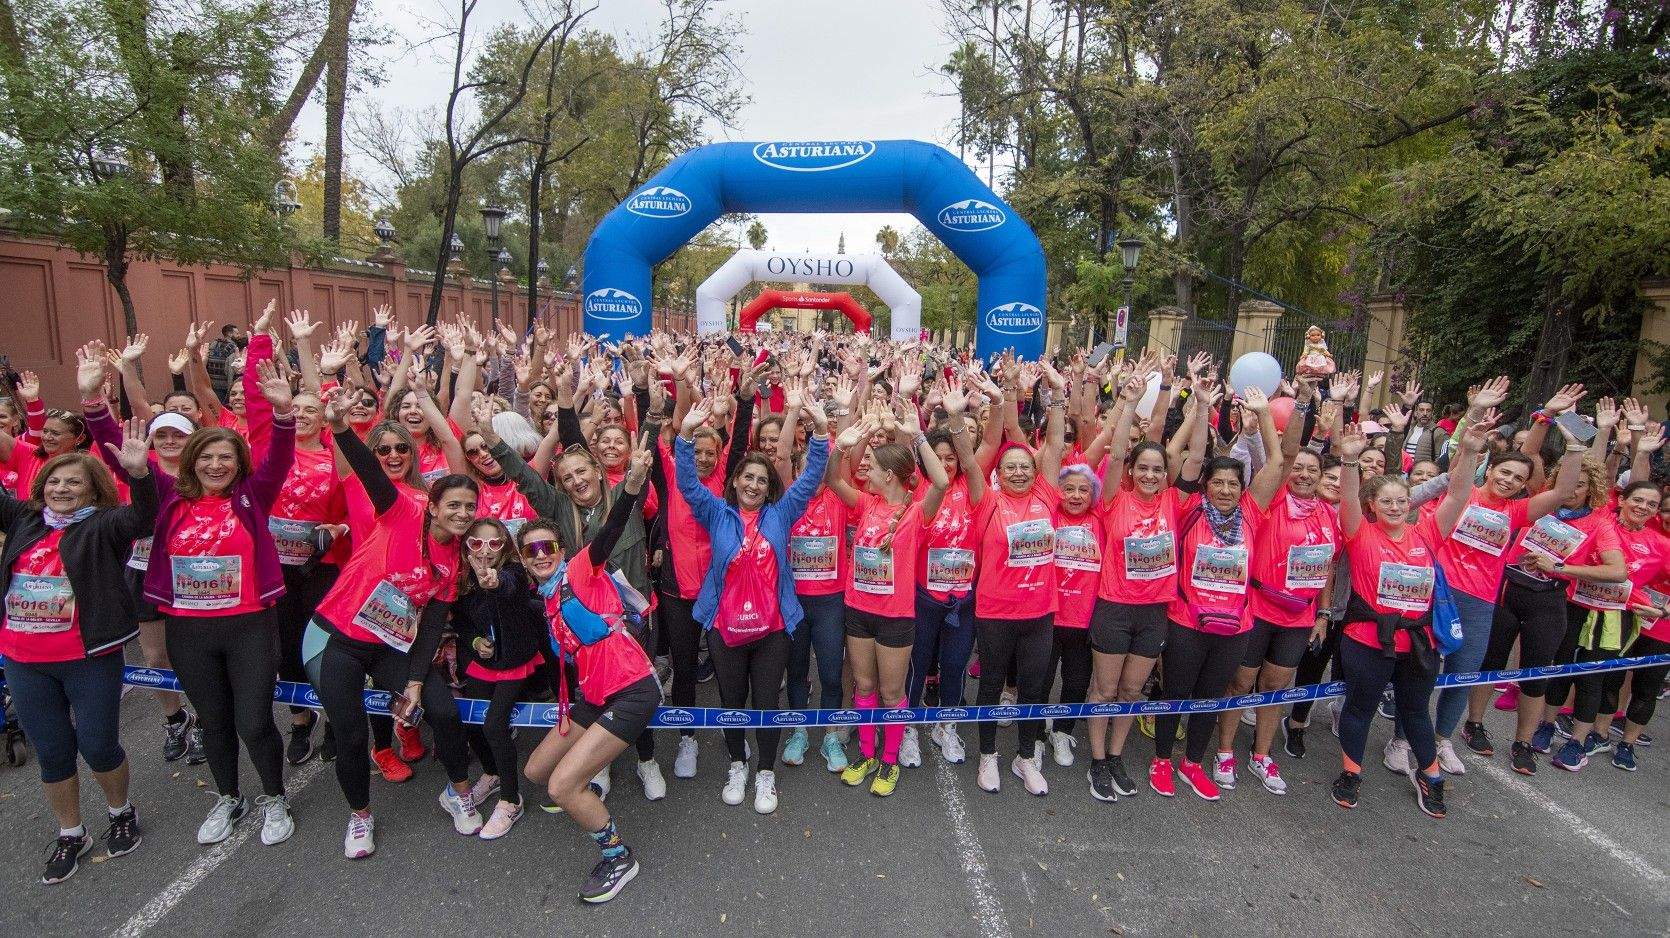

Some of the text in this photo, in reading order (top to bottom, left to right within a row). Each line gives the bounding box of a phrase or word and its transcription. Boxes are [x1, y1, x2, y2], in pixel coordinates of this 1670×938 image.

[762, 144, 866, 158] ASTURIANA
[630, 198, 687, 212] ASTURIANA
[943, 212, 1002, 224] ASTURIANA
[767, 256, 854, 277] OYSHO
[587, 299, 638, 313] ASTURIANA
[990, 314, 1040, 326] ASTURIANA
[193, 580, 218, 589] 016
[21, 600, 49, 610] 016
[383, 610, 406, 626] 016
[662, 714, 691, 722] ASTURIANA
